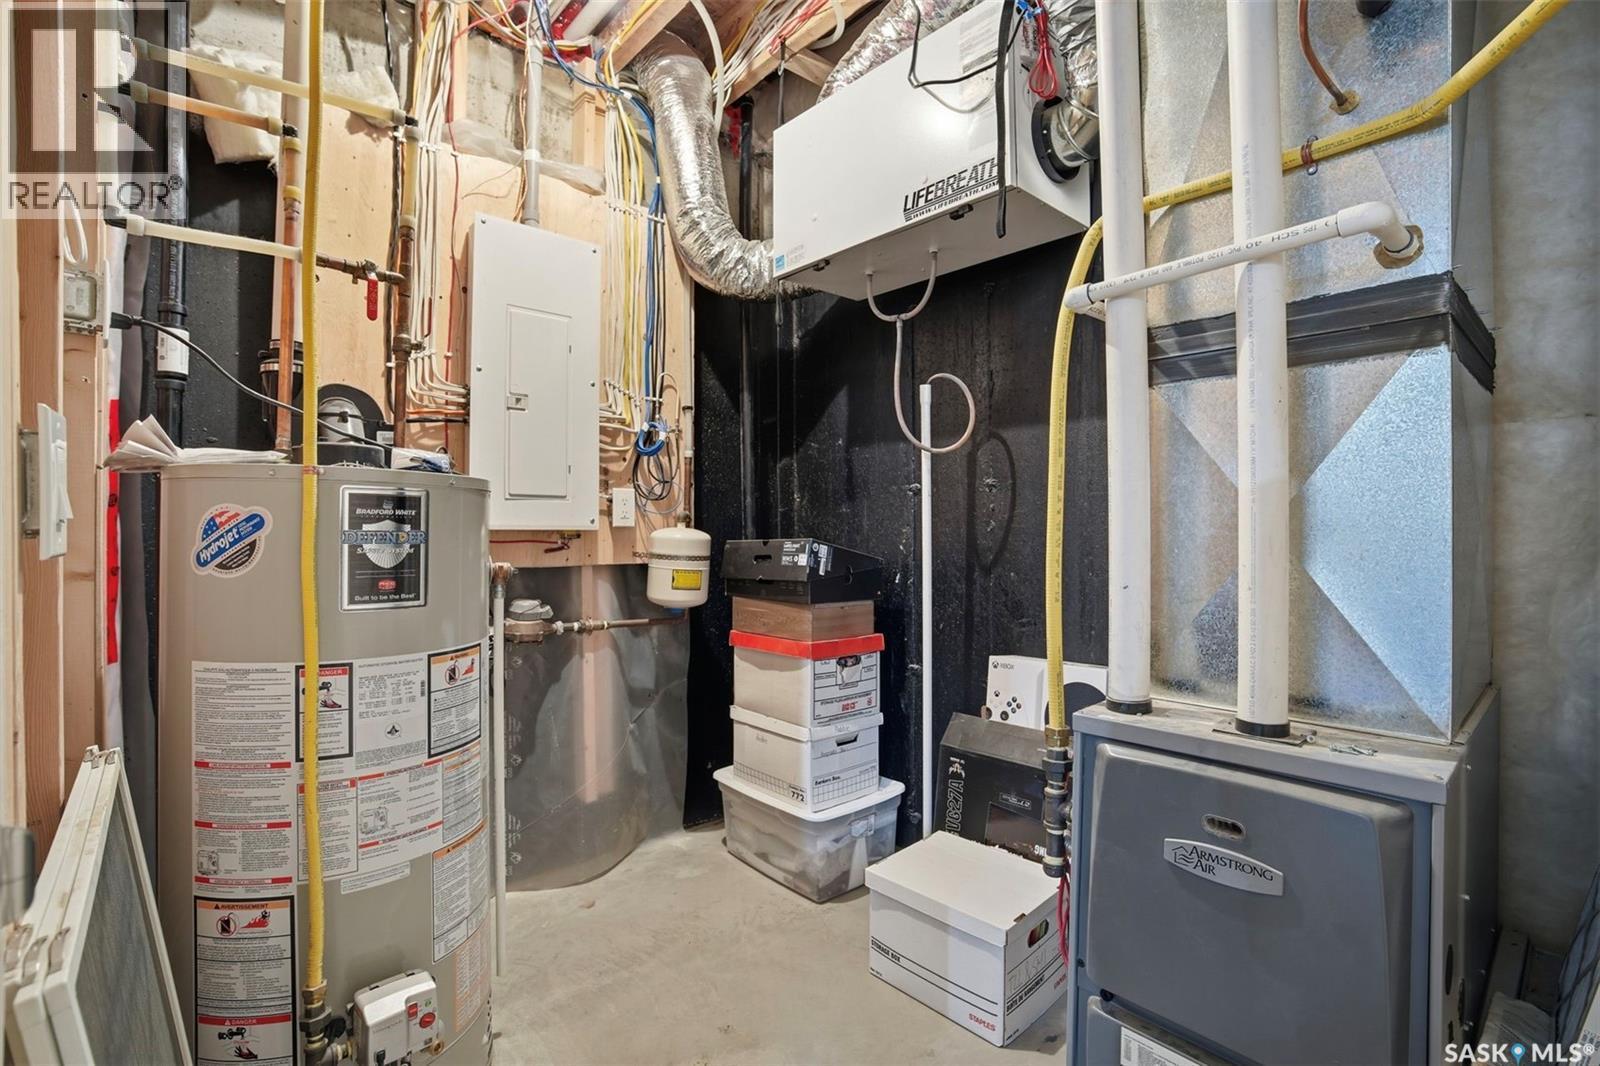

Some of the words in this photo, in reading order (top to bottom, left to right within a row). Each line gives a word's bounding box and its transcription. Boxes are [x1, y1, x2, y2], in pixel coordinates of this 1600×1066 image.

[1271, 231, 1301, 242] SCH
[1245, 240, 1262, 250] 40
[356, 508, 394, 516] BRADFORD
[200, 527, 240, 563] Hydrojet
[342, 529, 427, 545] DEFENDER
[318, 669, 343, 677] ANGER
[791, 791, 805, 802] 772
[1189, 846, 1274, 881] ARMSTRONG
[1193, 860, 1216, 876] AIR
[871, 939, 890, 957] STORAGE
[890, 951, 901, 962] BOX
[969, 1013, 996, 1032] STAPLES
